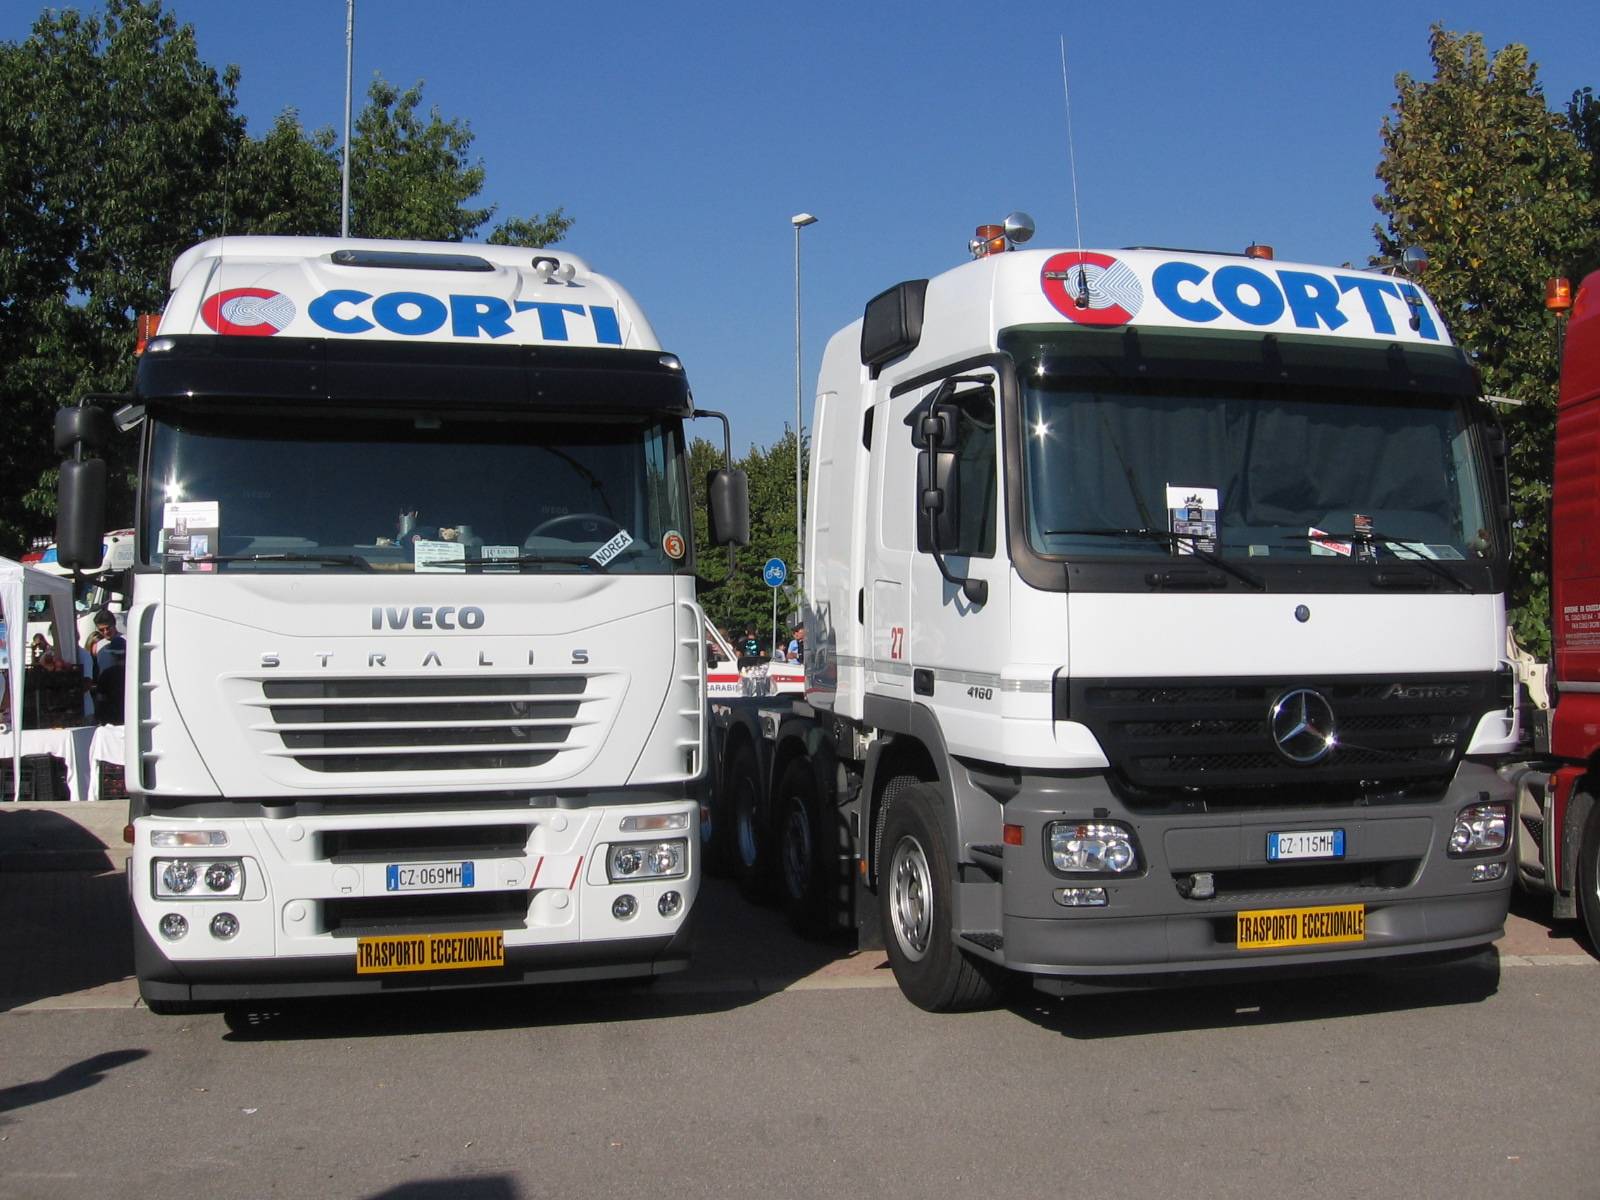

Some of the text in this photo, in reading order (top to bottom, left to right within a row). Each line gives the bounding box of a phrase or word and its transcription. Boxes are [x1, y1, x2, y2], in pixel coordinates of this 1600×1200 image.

[1151, 261, 1440, 341] CORTI
[307, 289, 623, 345] CORTI
[595, 534, 630, 565] NDREA
[670, 540, 681, 556] 3
[370, 606, 485, 631] IVECO
[891, 627, 904, 659] 27
[260, 648, 590, 668] STRALIS
[706, 684, 738, 692] CARABI
[966, 686, 993, 701] 4160
[1280, 837, 1293, 854] CZ
[1299, 836, 1333, 853] 115MH
[399, 869, 415, 886] CZ
[420, 867, 462, 885] 069MH
[1239, 909, 1363, 943] TRASPORTO ECCEZIONALE
[358, 935, 503, 968] TRASPORTO ECCEZIONALE
